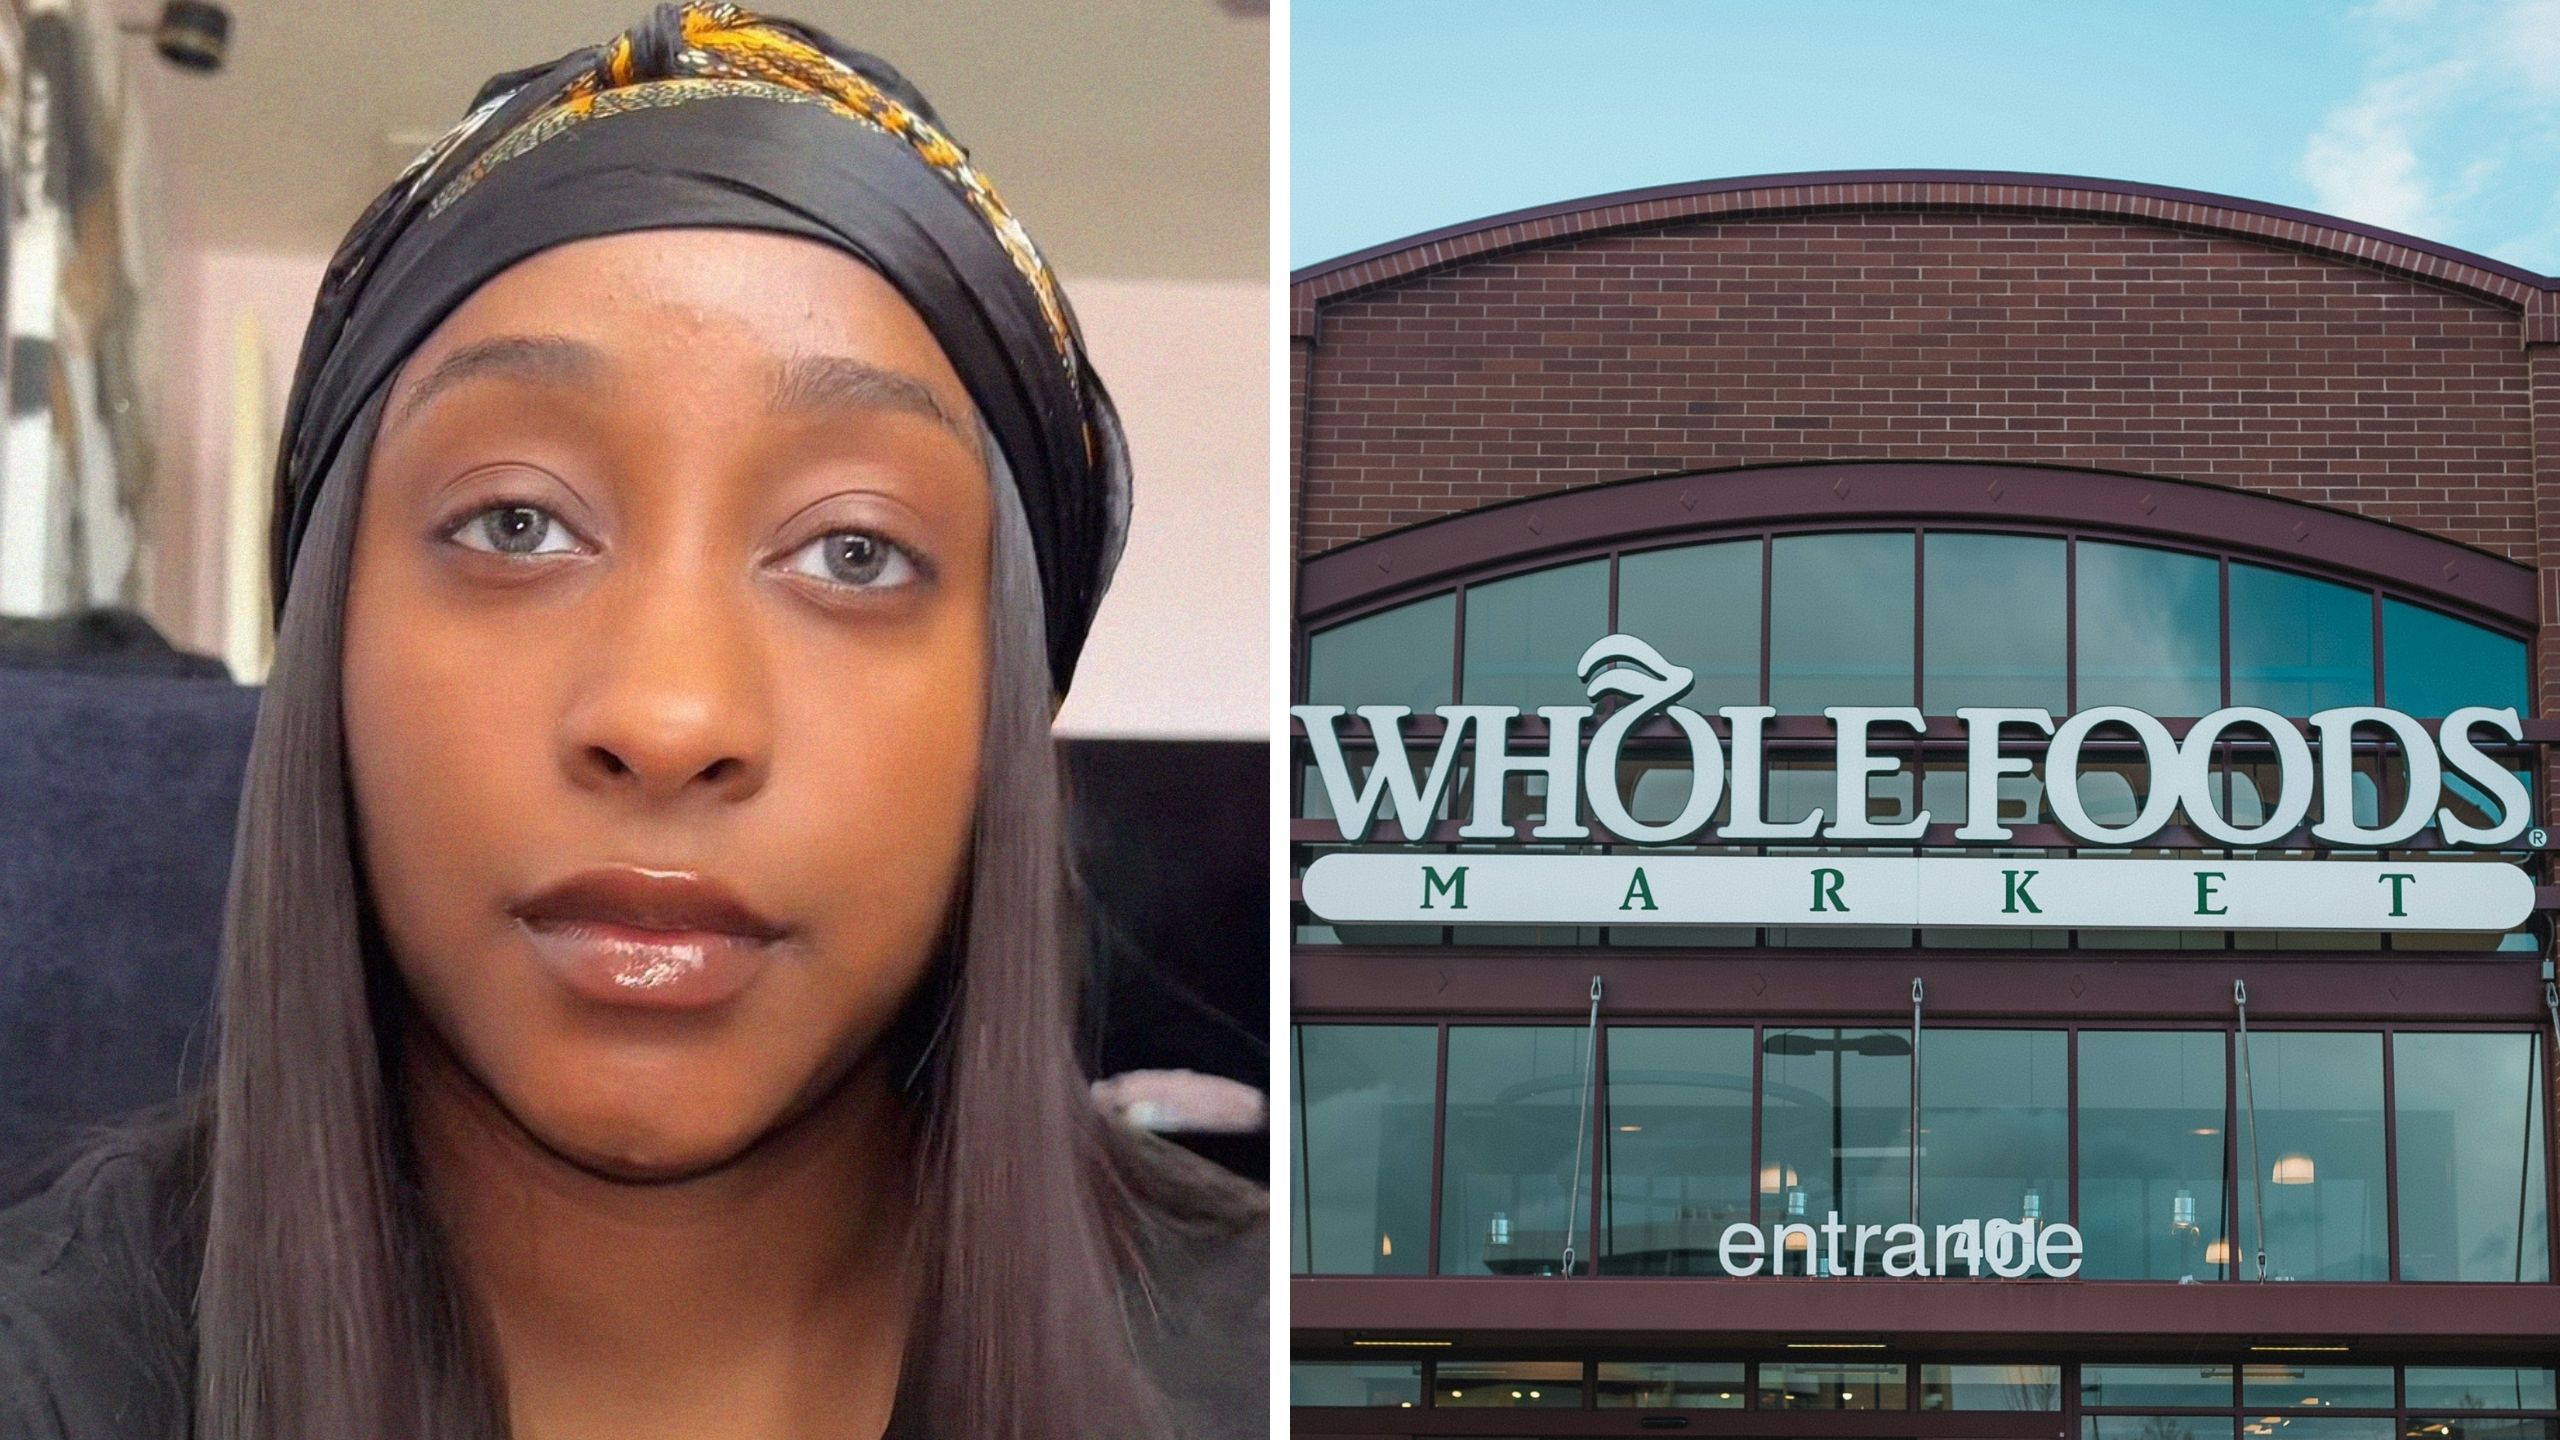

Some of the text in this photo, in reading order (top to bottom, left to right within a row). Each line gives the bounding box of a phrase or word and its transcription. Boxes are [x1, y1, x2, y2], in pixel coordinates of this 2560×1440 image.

[1290, 633, 1931, 844] WHOLE
[1954, 705, 2531, 846] FOODS
[1419, 866, 2417, 918] MARKET
[1718, 1210, 2084, 1278] entrance
